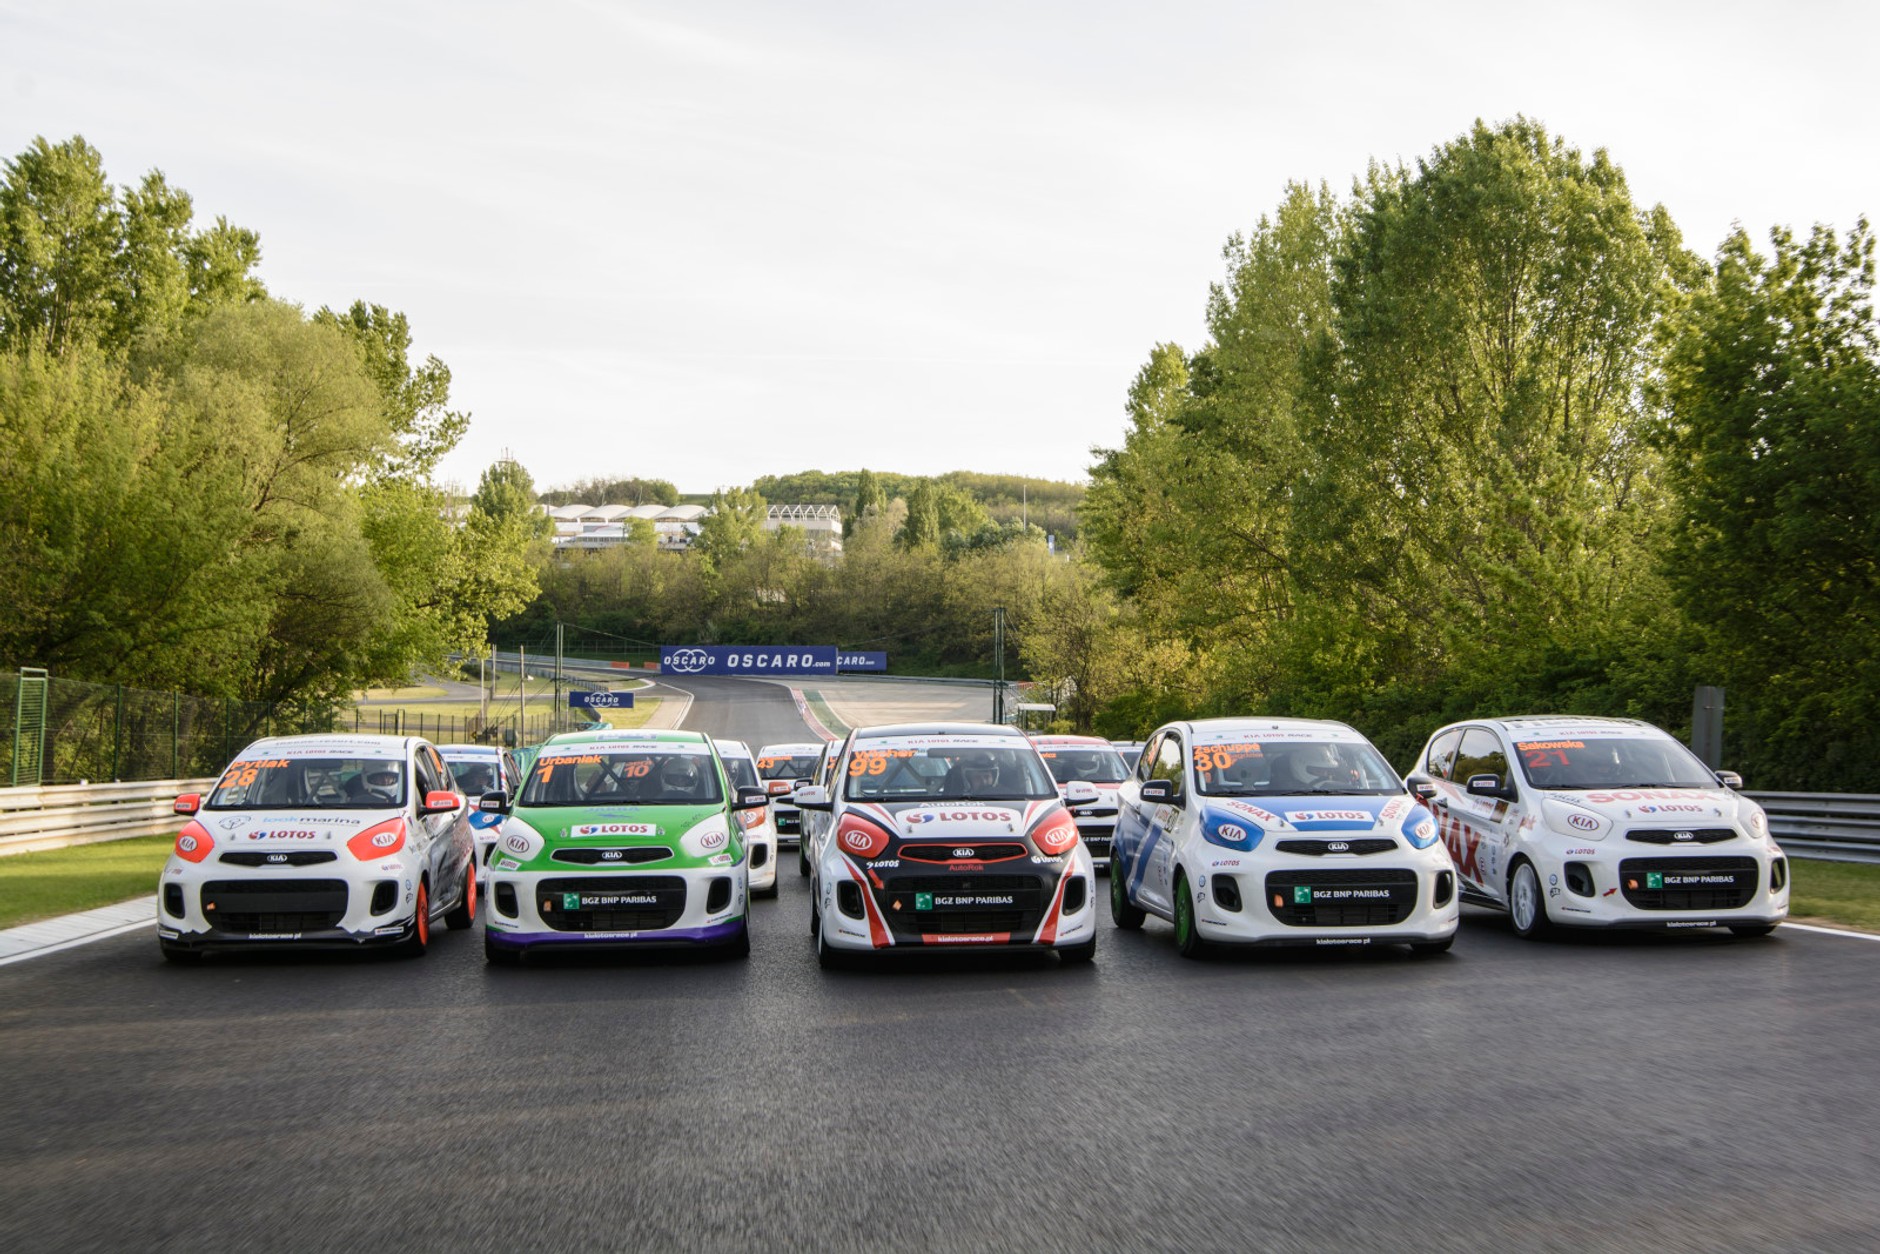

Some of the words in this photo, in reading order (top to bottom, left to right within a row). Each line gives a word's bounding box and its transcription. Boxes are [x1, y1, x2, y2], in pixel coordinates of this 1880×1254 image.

[664, 655, 716, 666] OSCARO
[1517, 740, 1585, 751] Sakowska
[539, 754, 602, 766] Urbaniak
[1193, 752, 1232, 772] 30
[1525, 750, 1571, 768] 21
[849, 757, 887, 776] 99
[219, 769, 258, 788] 28
[537, 765, 554, 784] 1
[940, 812, 1011, 821] LOTOS
[1226, 800, 1276, 822] SONAX
[1316, 811, 1365, 820] LOTOS
[1572, 816, 1593, 829] KIA
[269, 830, 316, 839] LOTOS
[601, 825, 648, 834] LOTOS
[1221, 826, 1242, 840] KIA
[374, 833, 394, 846] KIA
[705, 834, 722, 847] KIA
[847, 832, 867, 848] KIA
[1048, 829, 1068, 845] KIA
[180, 838, 194, 850] KIA
[509, 838, 526, 850] KIA
[874, 860, 900, 868] LOTOS
[949, 864, 984, 872] AutoRok
[1683, 876, 1700, 884] BNP
[1701, 875, 1734, 883] PARIBAS
[601, 896, 620, 904] BNP
[620, 895, 657, 904] PARIBAS
[955, 896, 974, 904] BNP
[975, 895, 1013, 904] PARIBAS
[1333, 890, 1352, 898] BNP
[1353, 889, 1390, 898] PARIBAS
